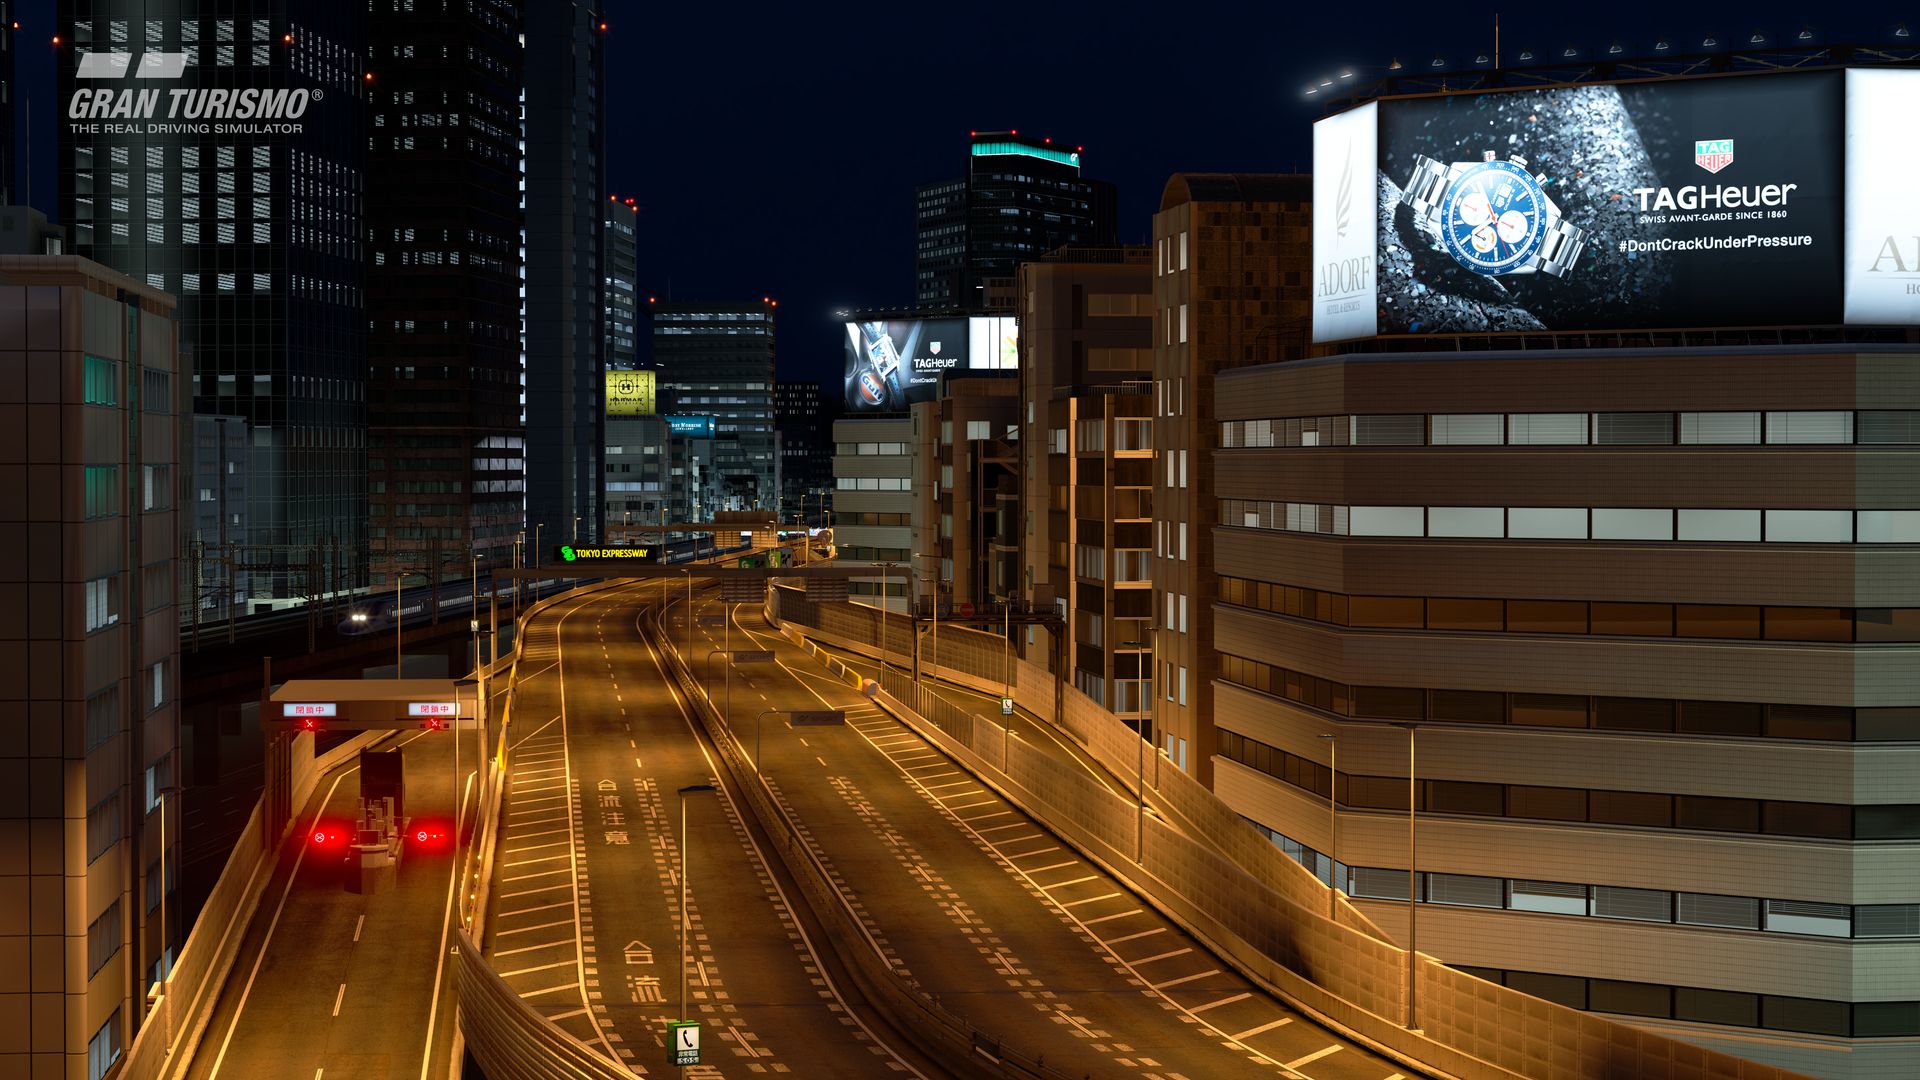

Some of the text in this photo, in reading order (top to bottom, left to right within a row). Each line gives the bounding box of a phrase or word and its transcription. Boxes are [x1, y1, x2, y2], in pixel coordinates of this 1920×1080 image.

[1699, 141, 1730, 154] TAG
[1696, 153, 1733, 170] HEUER
[1639, 210, 1788, 225] SWISS AVANT-GARDE SINCE 1860
[1618, 234, 1813, 253] #DontCrackUnderPressure
[1317, 255, 1372, 298] ADORF
[575, 548, 648, 558] TOKYO EXPRESSWAY
